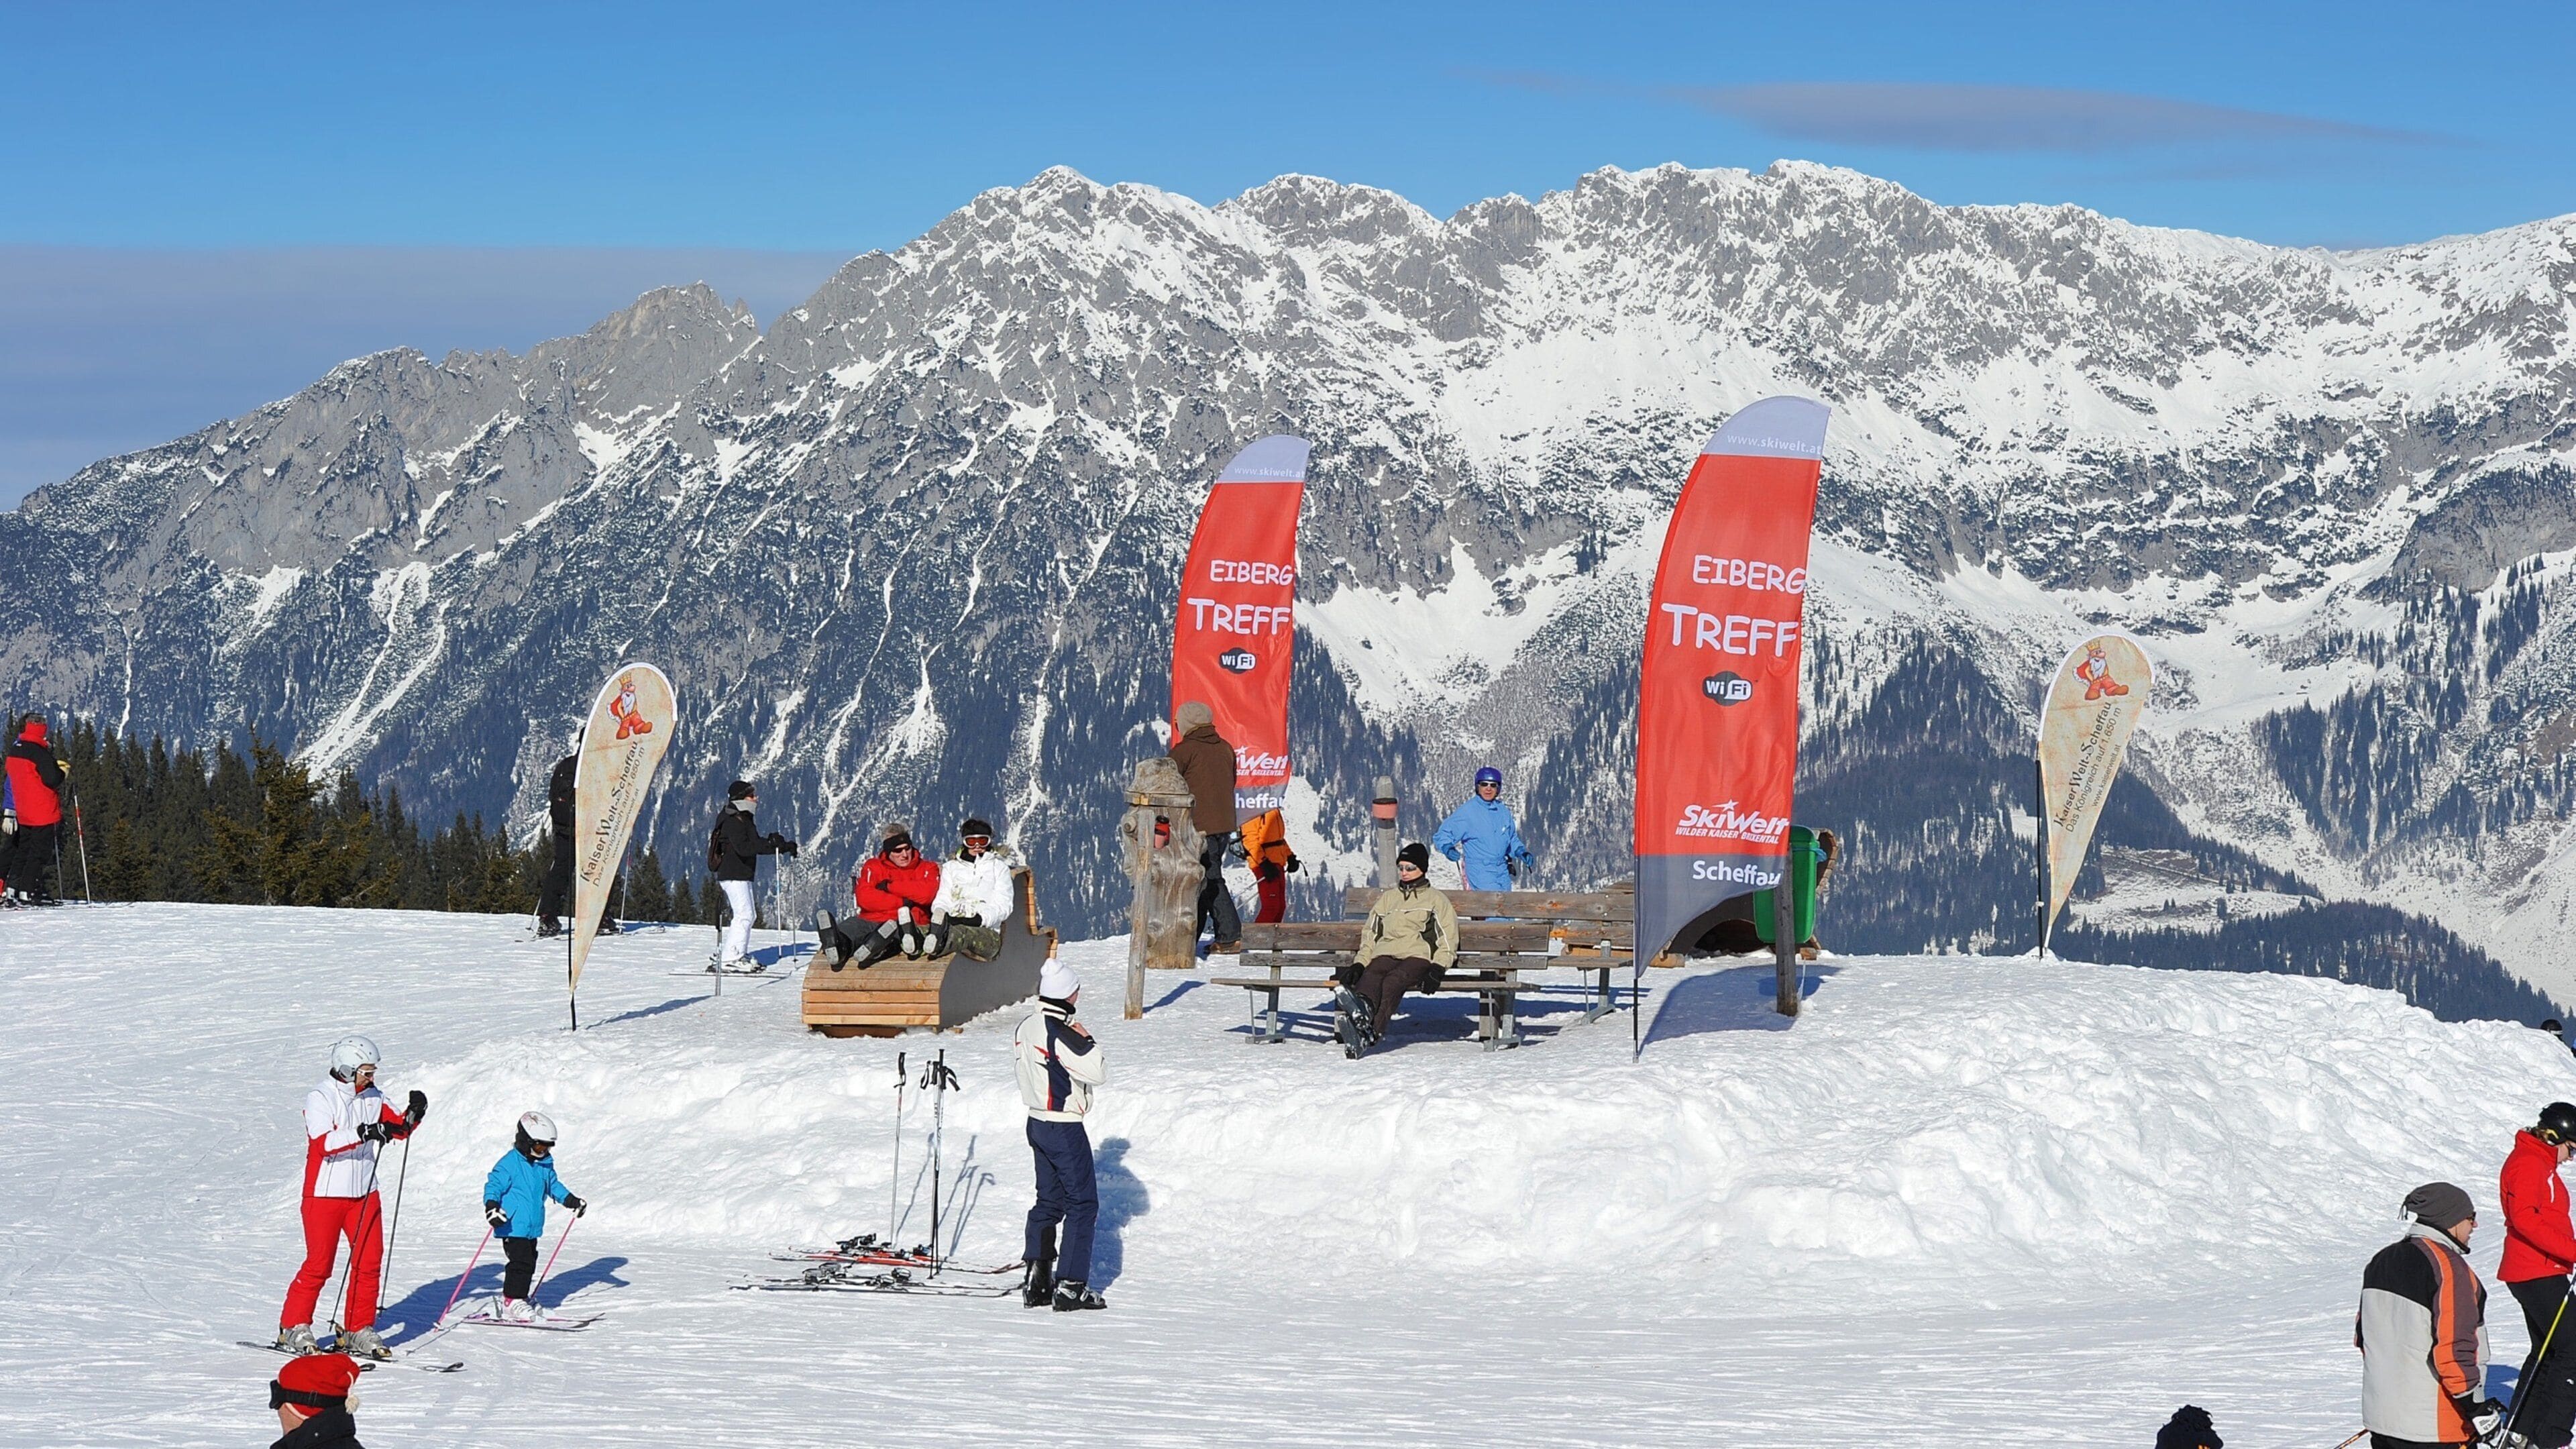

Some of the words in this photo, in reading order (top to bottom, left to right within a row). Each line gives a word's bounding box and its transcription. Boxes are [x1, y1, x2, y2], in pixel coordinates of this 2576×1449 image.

[1727, 435, 1822, 455] www.skiwelt.at
[1234, 468, 1305, 478] www.skiwelt.at
[1210, 559, 1293, 586] EIBERG
[1693, 554, 1807, 594] EIBERG
[1187, 597, 1291, 635] TREFF
[1661, 602, 1799, 657] TREFF
[638, 747, 645, 758] m
[1236, 752, 1288, 771] Welt
[2053, 702, 2111, 827] KaiserWelt-Scheffau
[2065, 814, 2080, 833] Das
[2074, 763, 2099, 812] Königreich
[2096, 745, 2106, 762] auf
[2101, 718, 2116, 743] 1.650
[2113, 707, 2121, 717] m
[2092, 744, 2121, 806] www.kaiserwelt.at
[580, 741, 637, 882] KaiserWelt-Scheffau
[1678, 804, 1790, 836] SkiWelt
[1675, 827, 1707, 837] WILDER
[1708, 830, 1739, 839] KAISER
[1693, 860, 1782, 886] Scheffau
